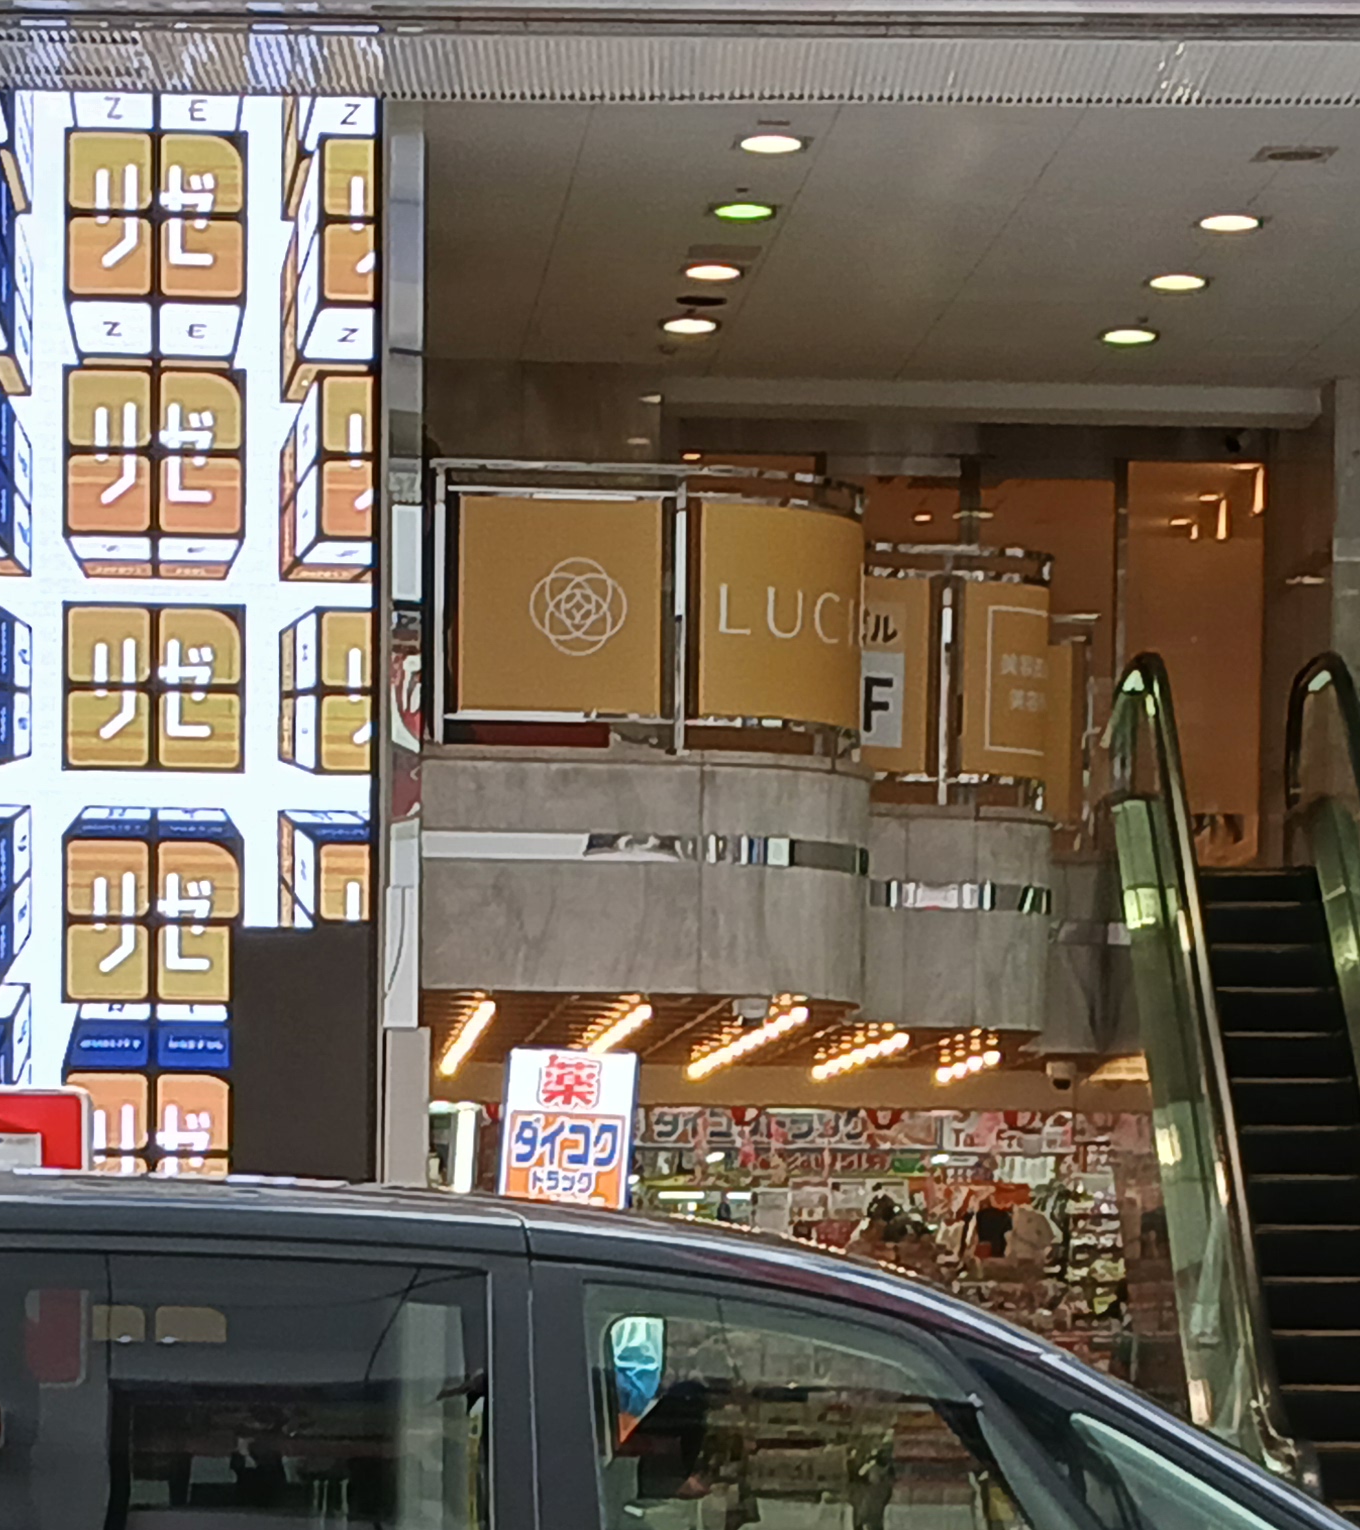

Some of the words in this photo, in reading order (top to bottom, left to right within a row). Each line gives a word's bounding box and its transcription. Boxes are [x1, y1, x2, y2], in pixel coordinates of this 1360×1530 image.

[99, 163, 214, 268] リゼ
[99, 401, 213, 505] リゼ
[95, 637, 213, 739] リゼ
[95, 871, 212, 973] リゼ
[542, 1054, 598, 1105] 薬
[515, 1117, 618, 1166] ダイコク
